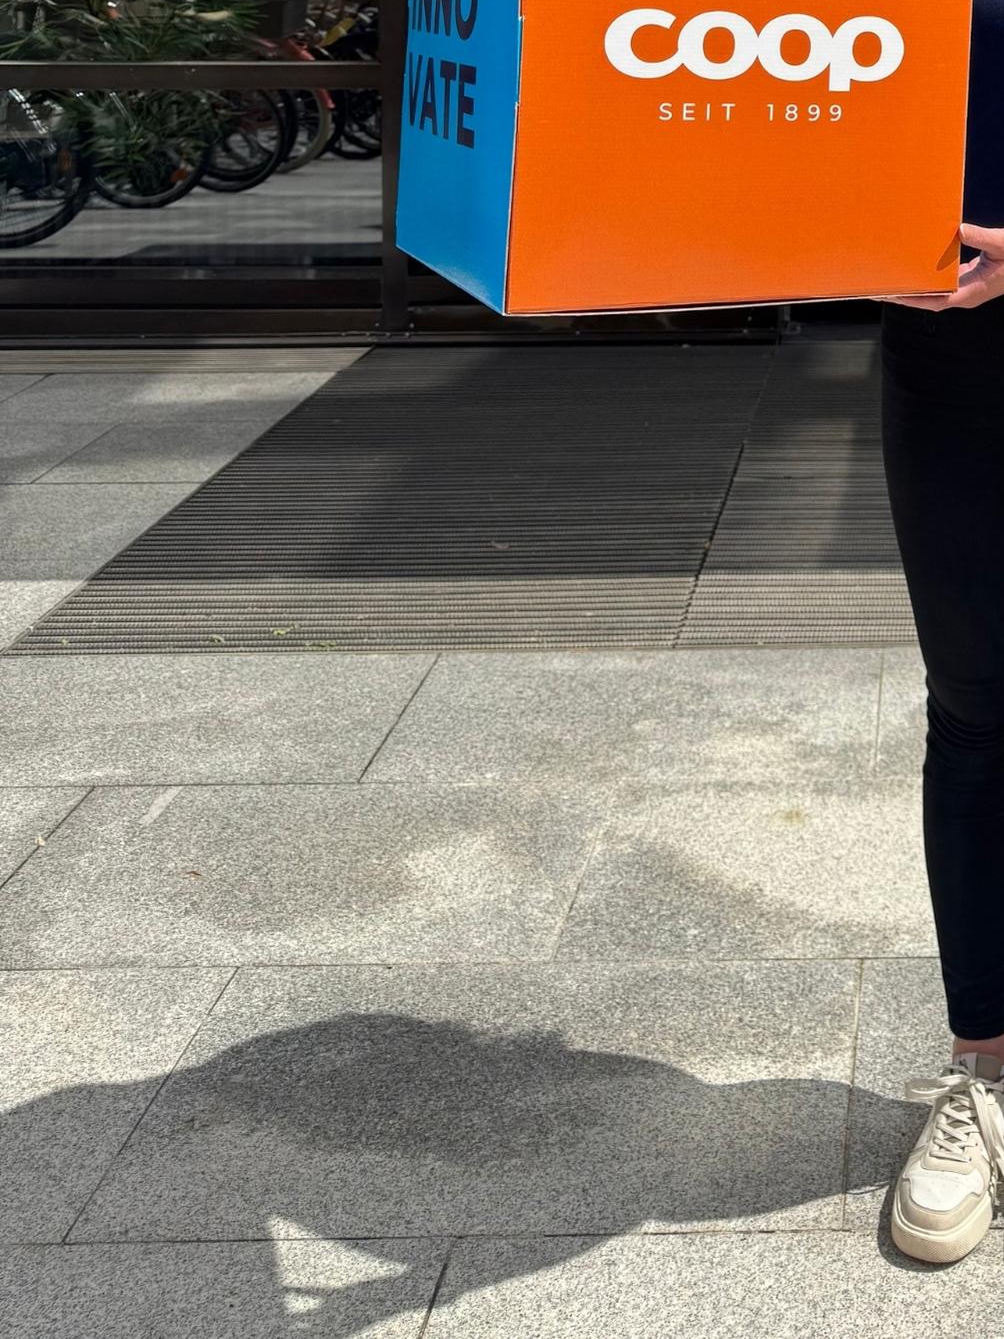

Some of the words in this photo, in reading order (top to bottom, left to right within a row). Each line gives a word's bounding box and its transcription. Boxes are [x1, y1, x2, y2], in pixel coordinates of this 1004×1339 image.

[604, 7, 905, 92] coop
[407, 52, 477, 149] VATE
[658, 102, 736, 121] SEIT
[766, 103, 843, 122] 1899
